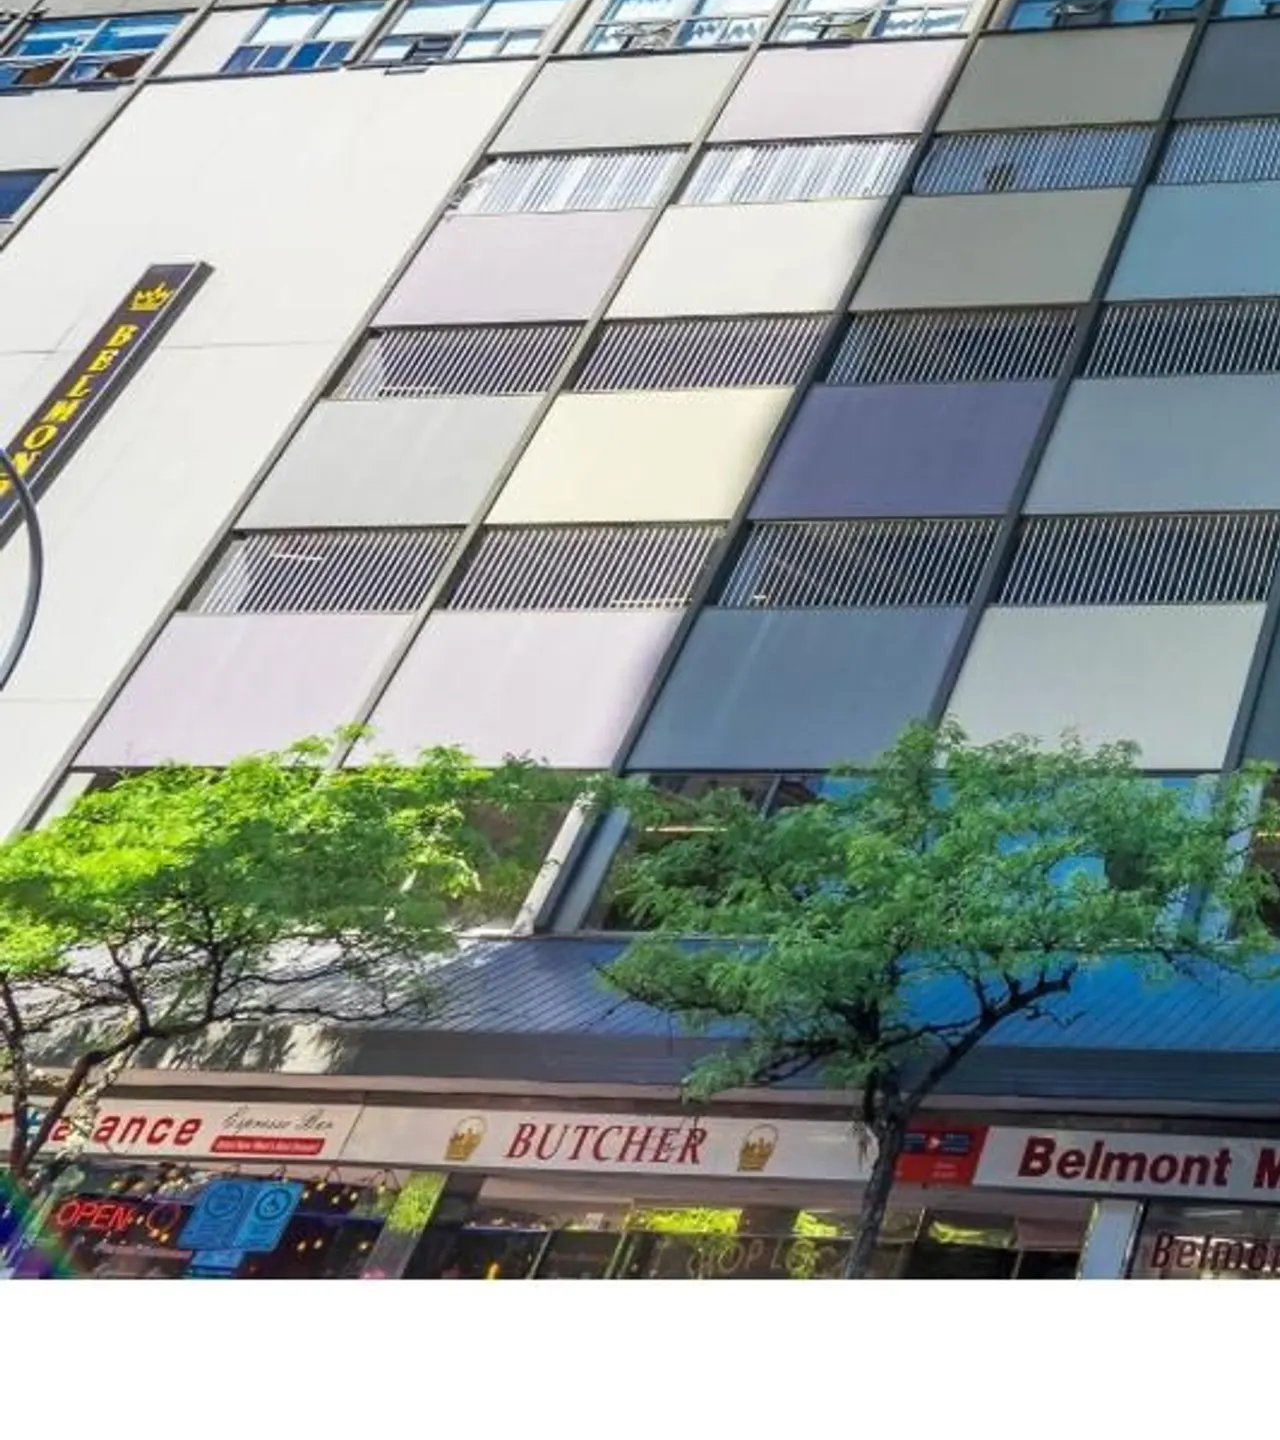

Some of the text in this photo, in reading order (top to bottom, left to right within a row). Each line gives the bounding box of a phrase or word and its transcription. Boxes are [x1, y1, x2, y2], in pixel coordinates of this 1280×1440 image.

[26, 1106, 203, 1147] aance
[503, 1122, 708, 1164] BUTCHER
[1018, 1137, 1233, 1188] Belmont
[56, 1199, 132, 1232] OPEN
